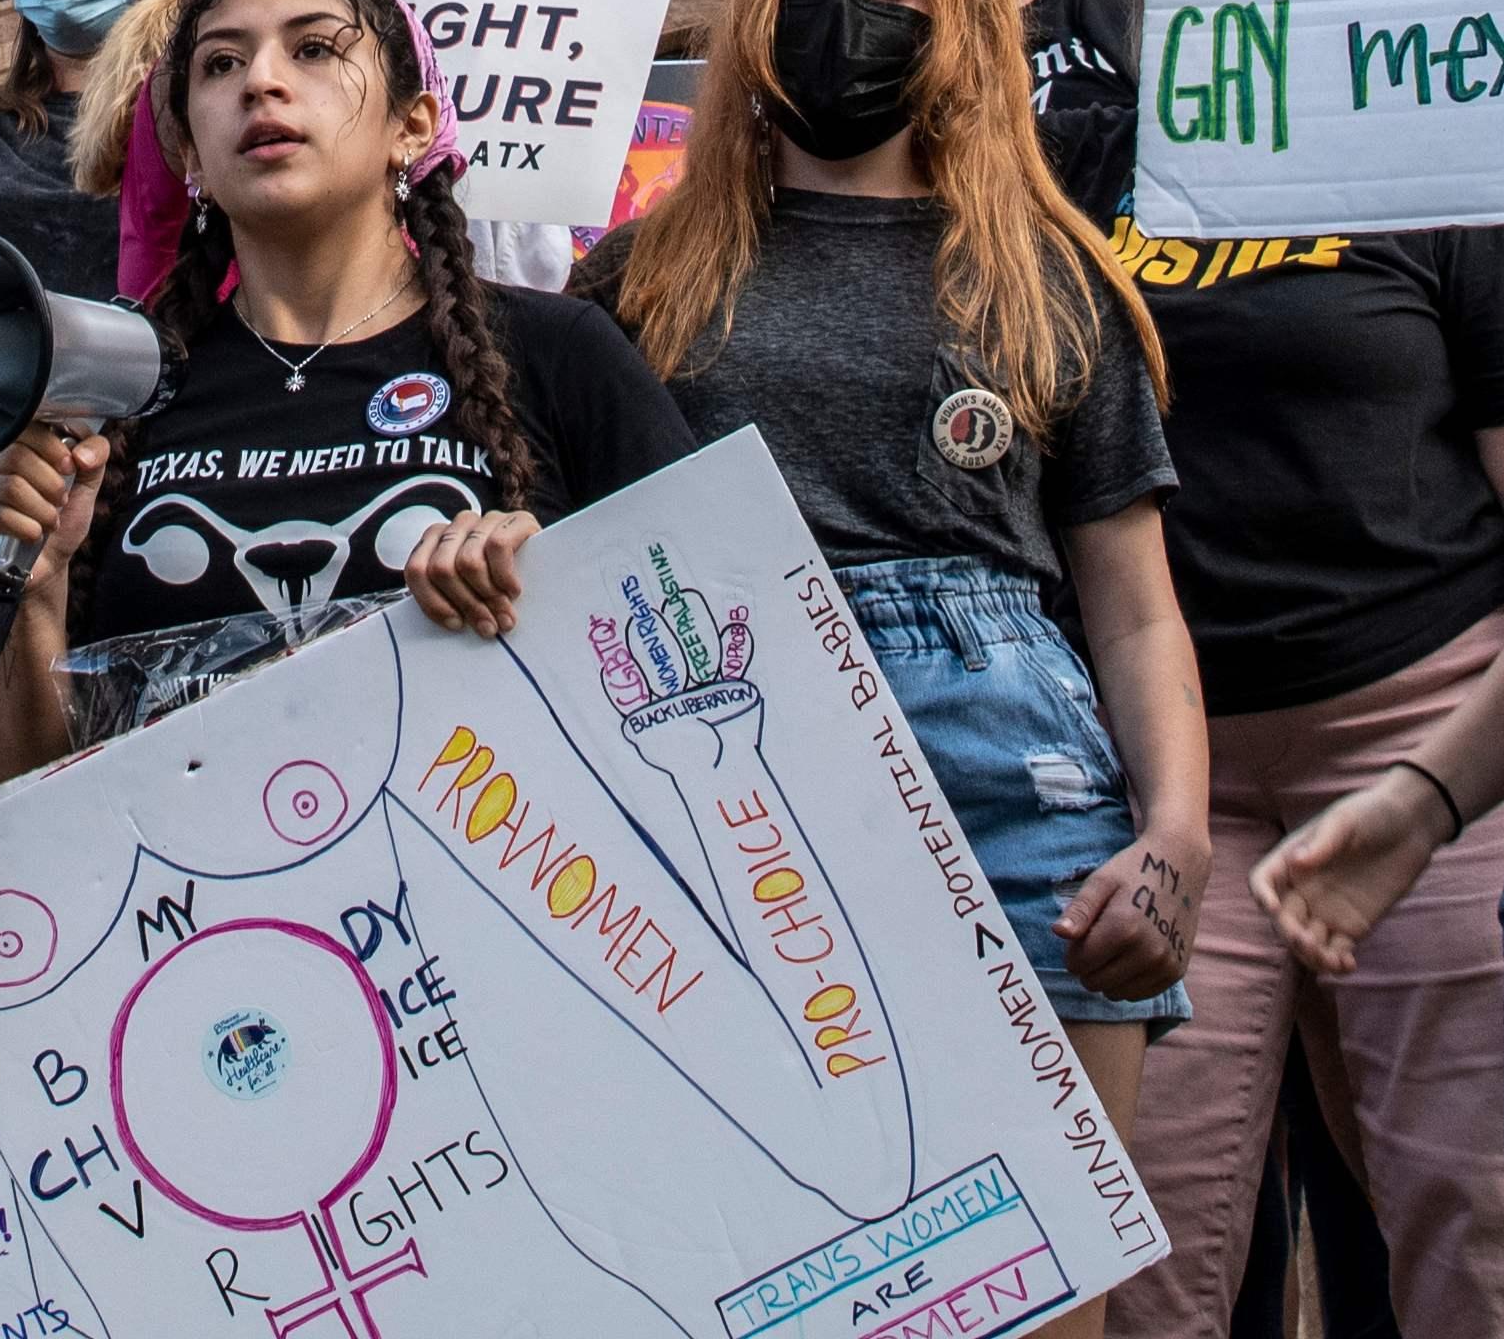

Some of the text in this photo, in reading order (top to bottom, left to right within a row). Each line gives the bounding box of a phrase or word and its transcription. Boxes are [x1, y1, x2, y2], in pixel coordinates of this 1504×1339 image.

[408, 1, 585, 62] GHT,
[445, 74, 604, 128] URE
[469, 140, 545, 170] ATX
[938, 395, 1009, 453] WOMEN'S MARCH ATX
[137, 435, 493, 496] TEXAS, WE NEED TO TALK
[629, 687, 753, 734] BLACK LIBERATION
[135, 879, 196, 961] MY
[717, 788, 887, 1077] PRO-CHOICE
[785, 557, 1157, 1258] LIVING WOMEN POTENTIAL BABIES!
[727, 1169, 1007, 1326] TRANS WOMEN
[850, 1261, 933, 1326] ARE
